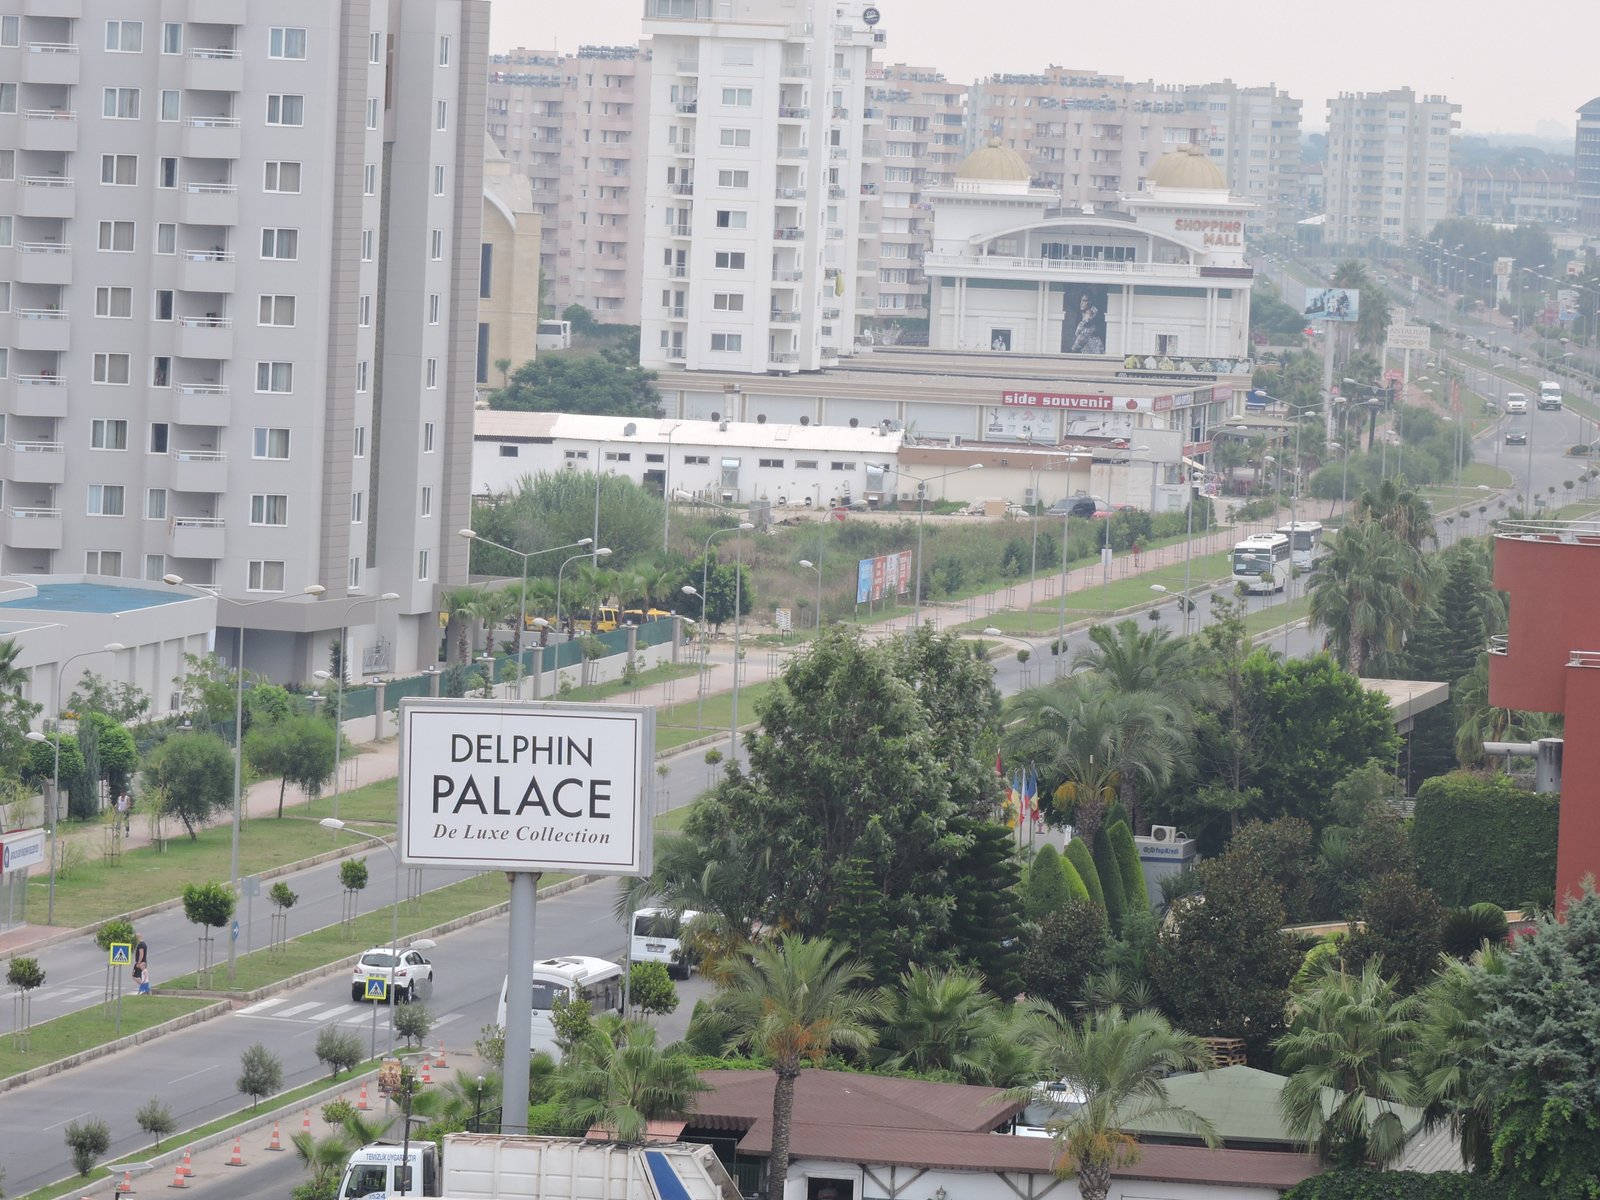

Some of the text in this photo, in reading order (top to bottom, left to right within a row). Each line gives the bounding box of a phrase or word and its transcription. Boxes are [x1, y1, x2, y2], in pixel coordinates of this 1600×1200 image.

[1175, 218, 1241, 233] SHOPPING
[1203, 232, 1241, 247] MALL
[1004, 393, 1111, 409] side souvenir
[451, 734, 593, 767] DELPHIN
[432, 774, 612, 819] PALACE
[433, 823, 610, 844] De Luxe Collection
